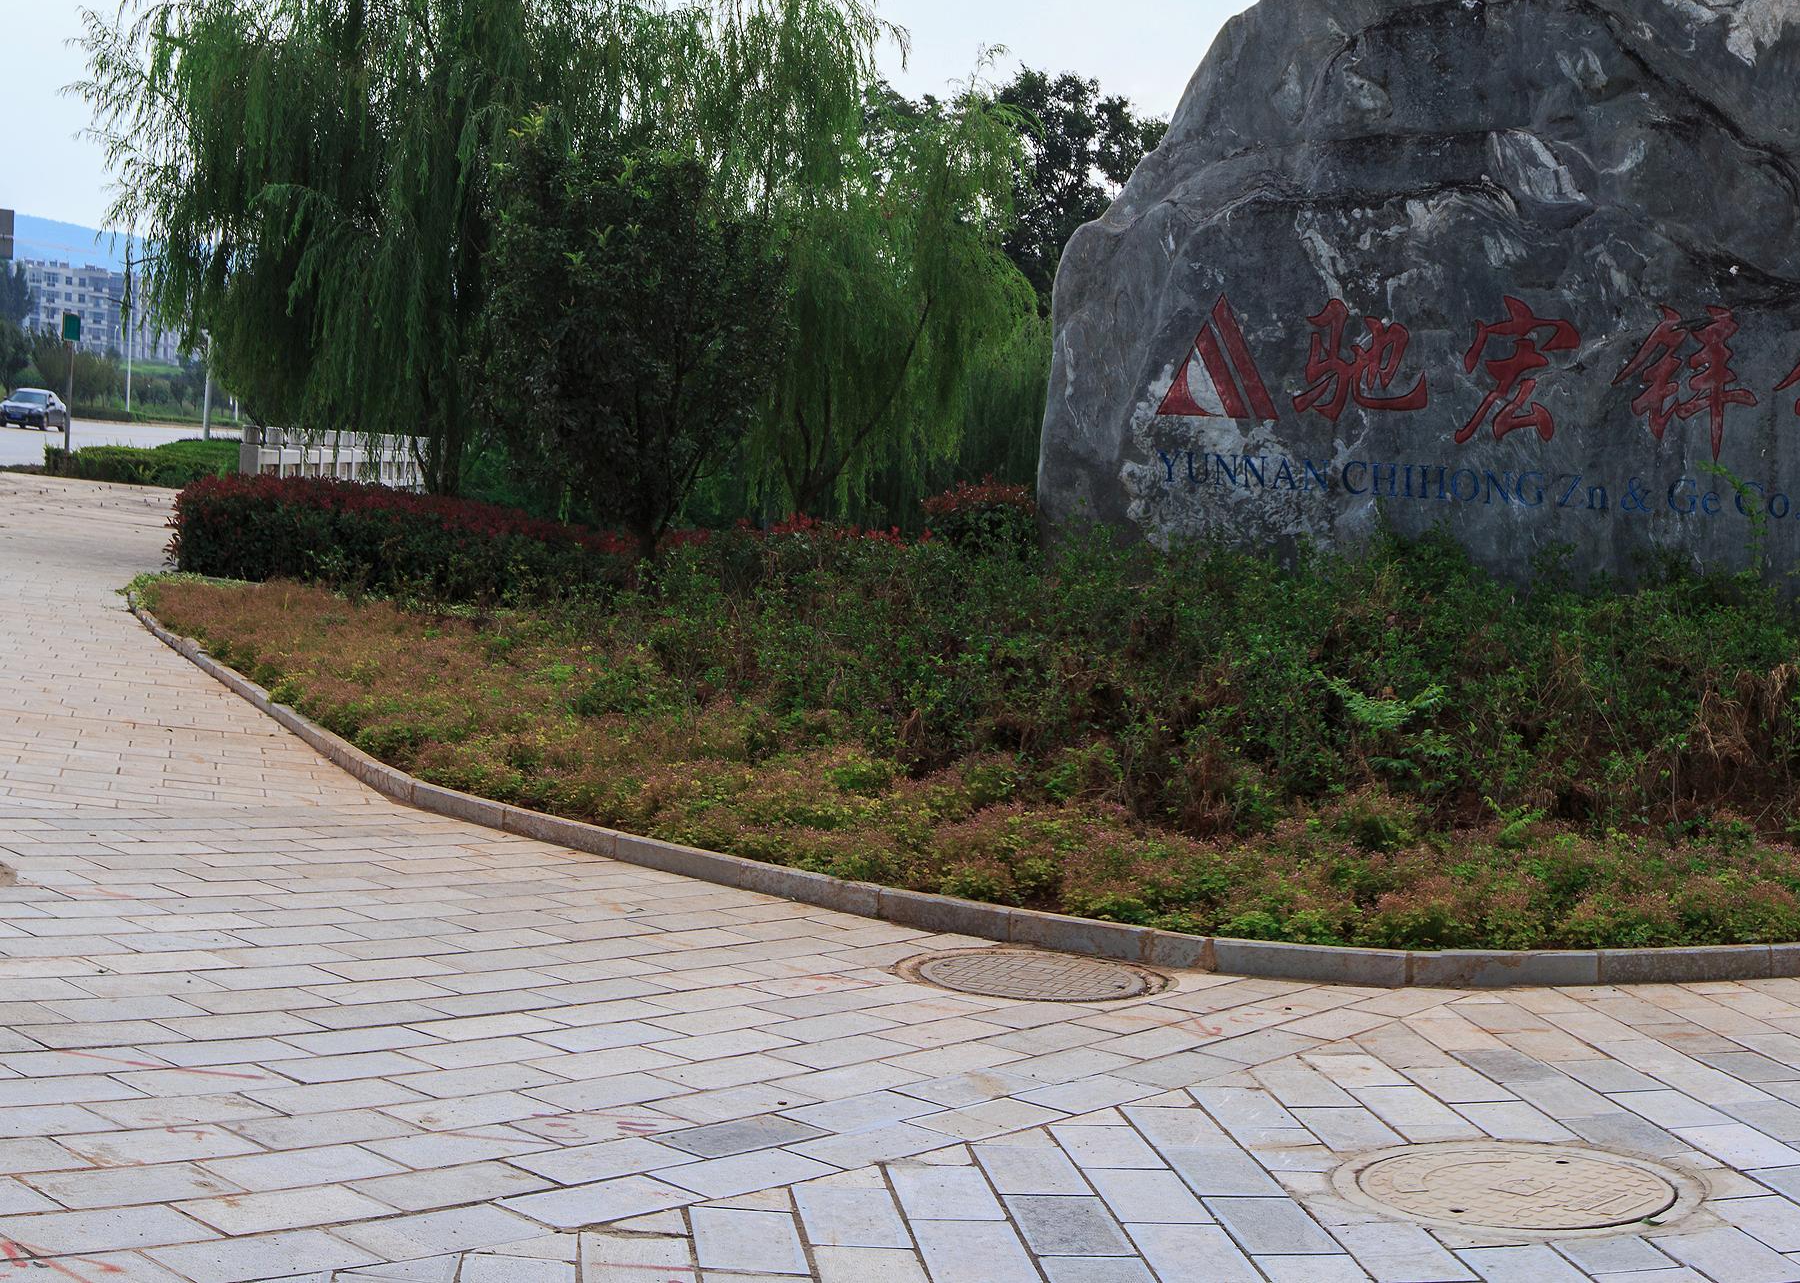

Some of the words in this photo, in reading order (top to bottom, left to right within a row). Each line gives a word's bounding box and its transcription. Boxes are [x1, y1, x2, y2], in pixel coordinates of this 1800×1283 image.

[1156, 448, 1329, 493] YUNNAN
[1341, 459, 1544, 509] CHIHONG
[1557, 473, 1609, 512] Zn
[1619, 475, 1653, 514] &
[1667, 477, 1723, 517] Ge
